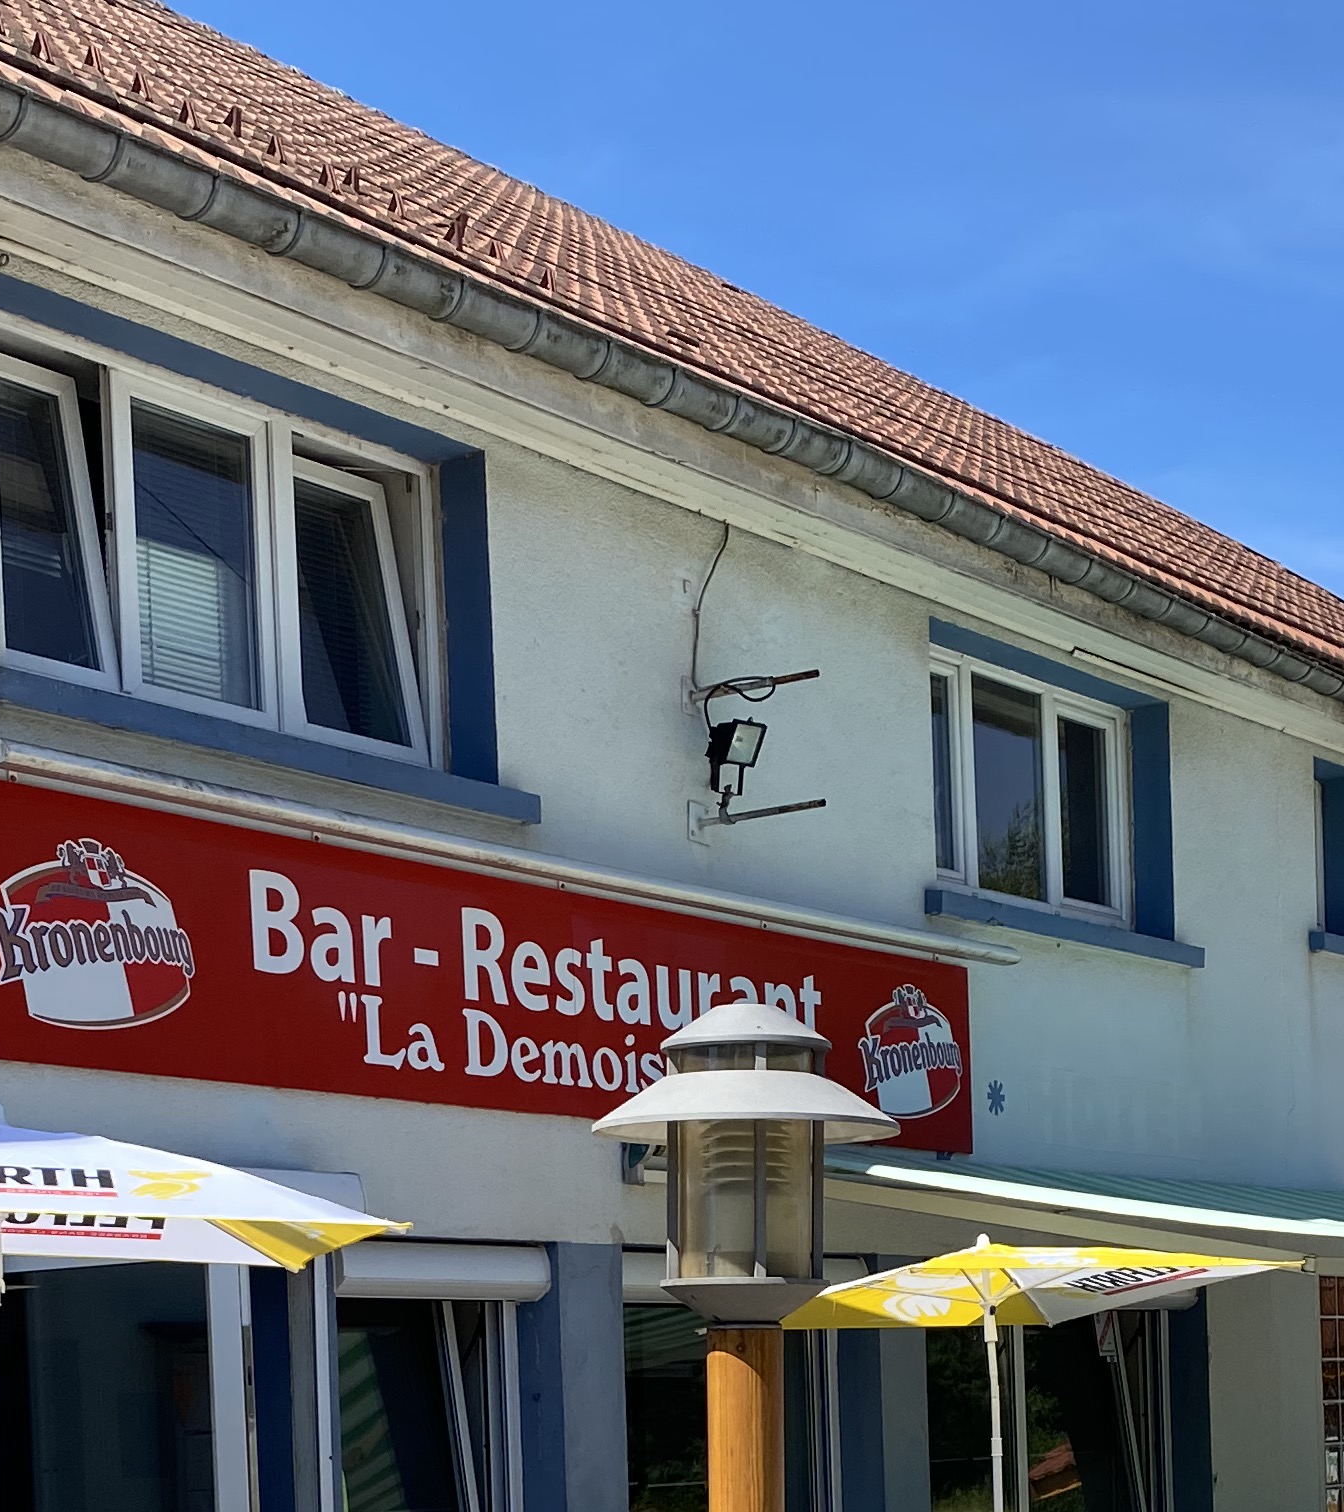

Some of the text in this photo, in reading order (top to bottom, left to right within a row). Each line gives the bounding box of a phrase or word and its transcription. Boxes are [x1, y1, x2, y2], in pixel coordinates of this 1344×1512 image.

[248, 868, 392, 987] Bar
[413, 946, 439, 967] -
[337, 990, 667, 1093] "La Demois
[859, 1032, 962, 1092] Kronenbourg
